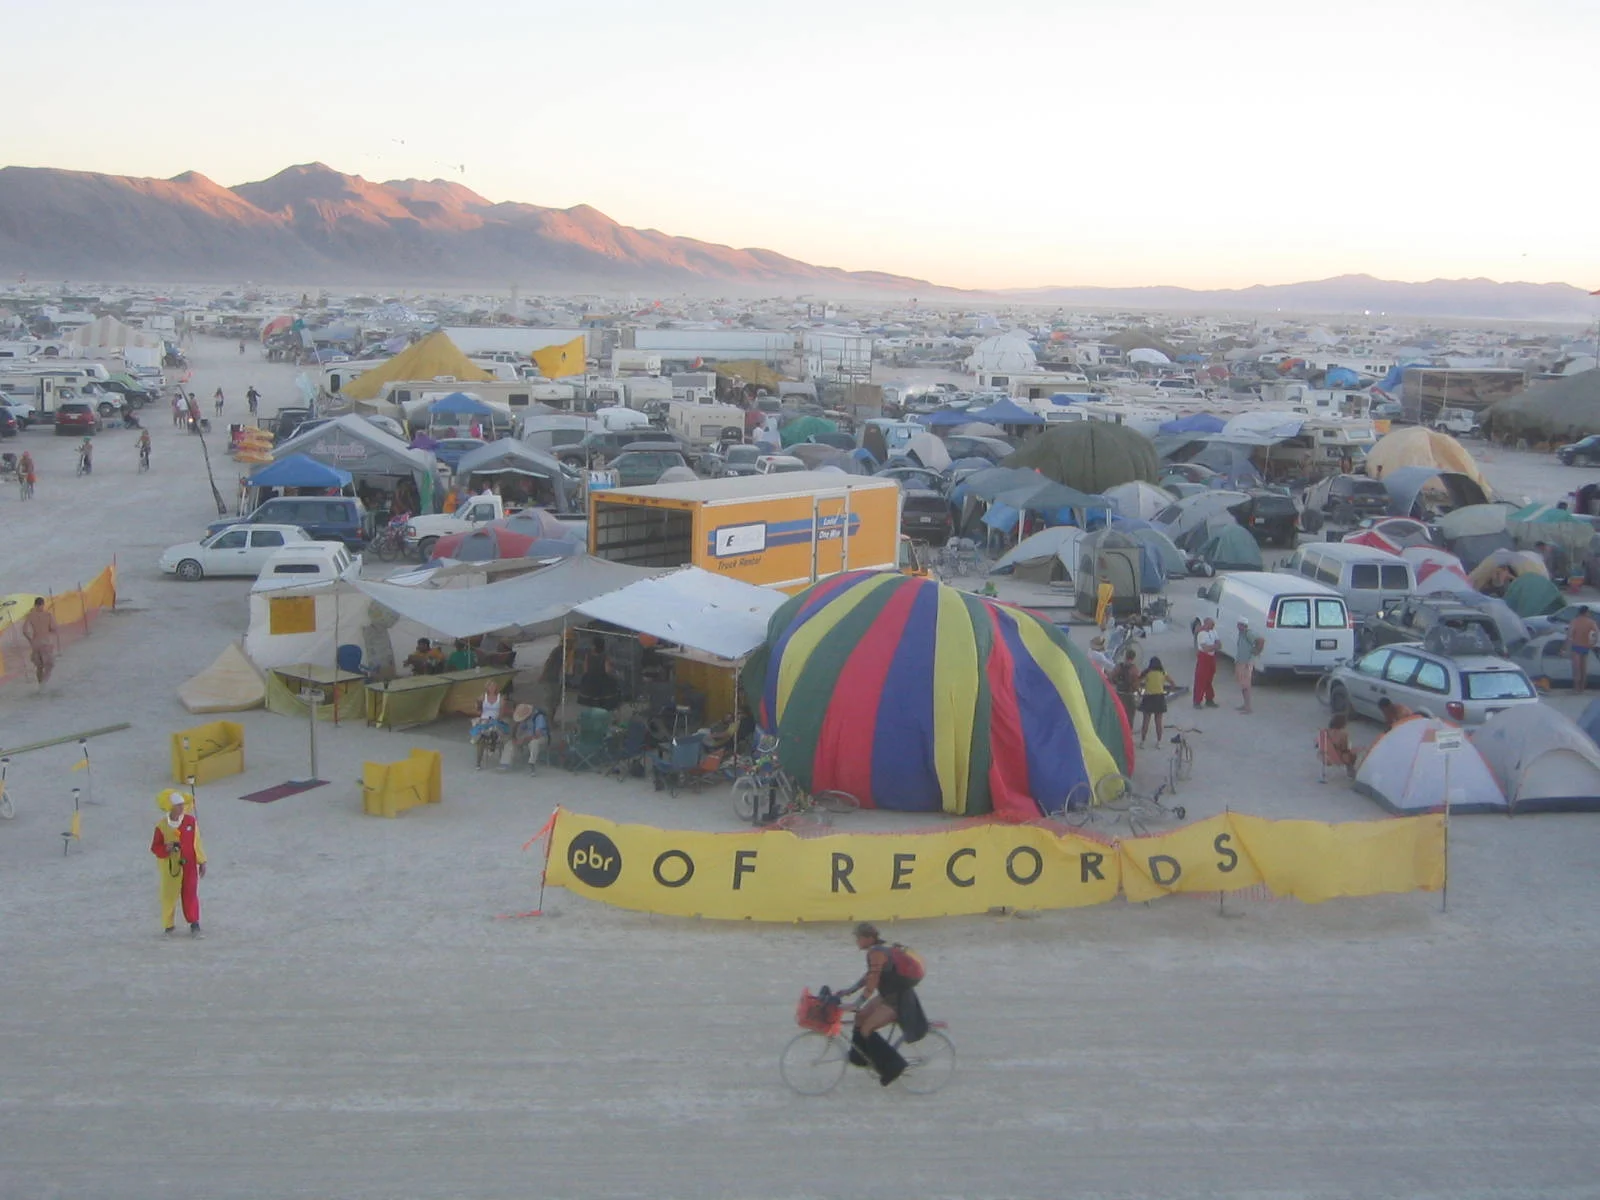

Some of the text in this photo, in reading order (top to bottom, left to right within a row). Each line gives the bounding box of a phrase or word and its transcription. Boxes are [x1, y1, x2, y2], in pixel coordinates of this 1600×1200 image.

[717, 555, 762, 570] Truck Rental
[572, 833, 1239, 893] pbr OF RECORDS
